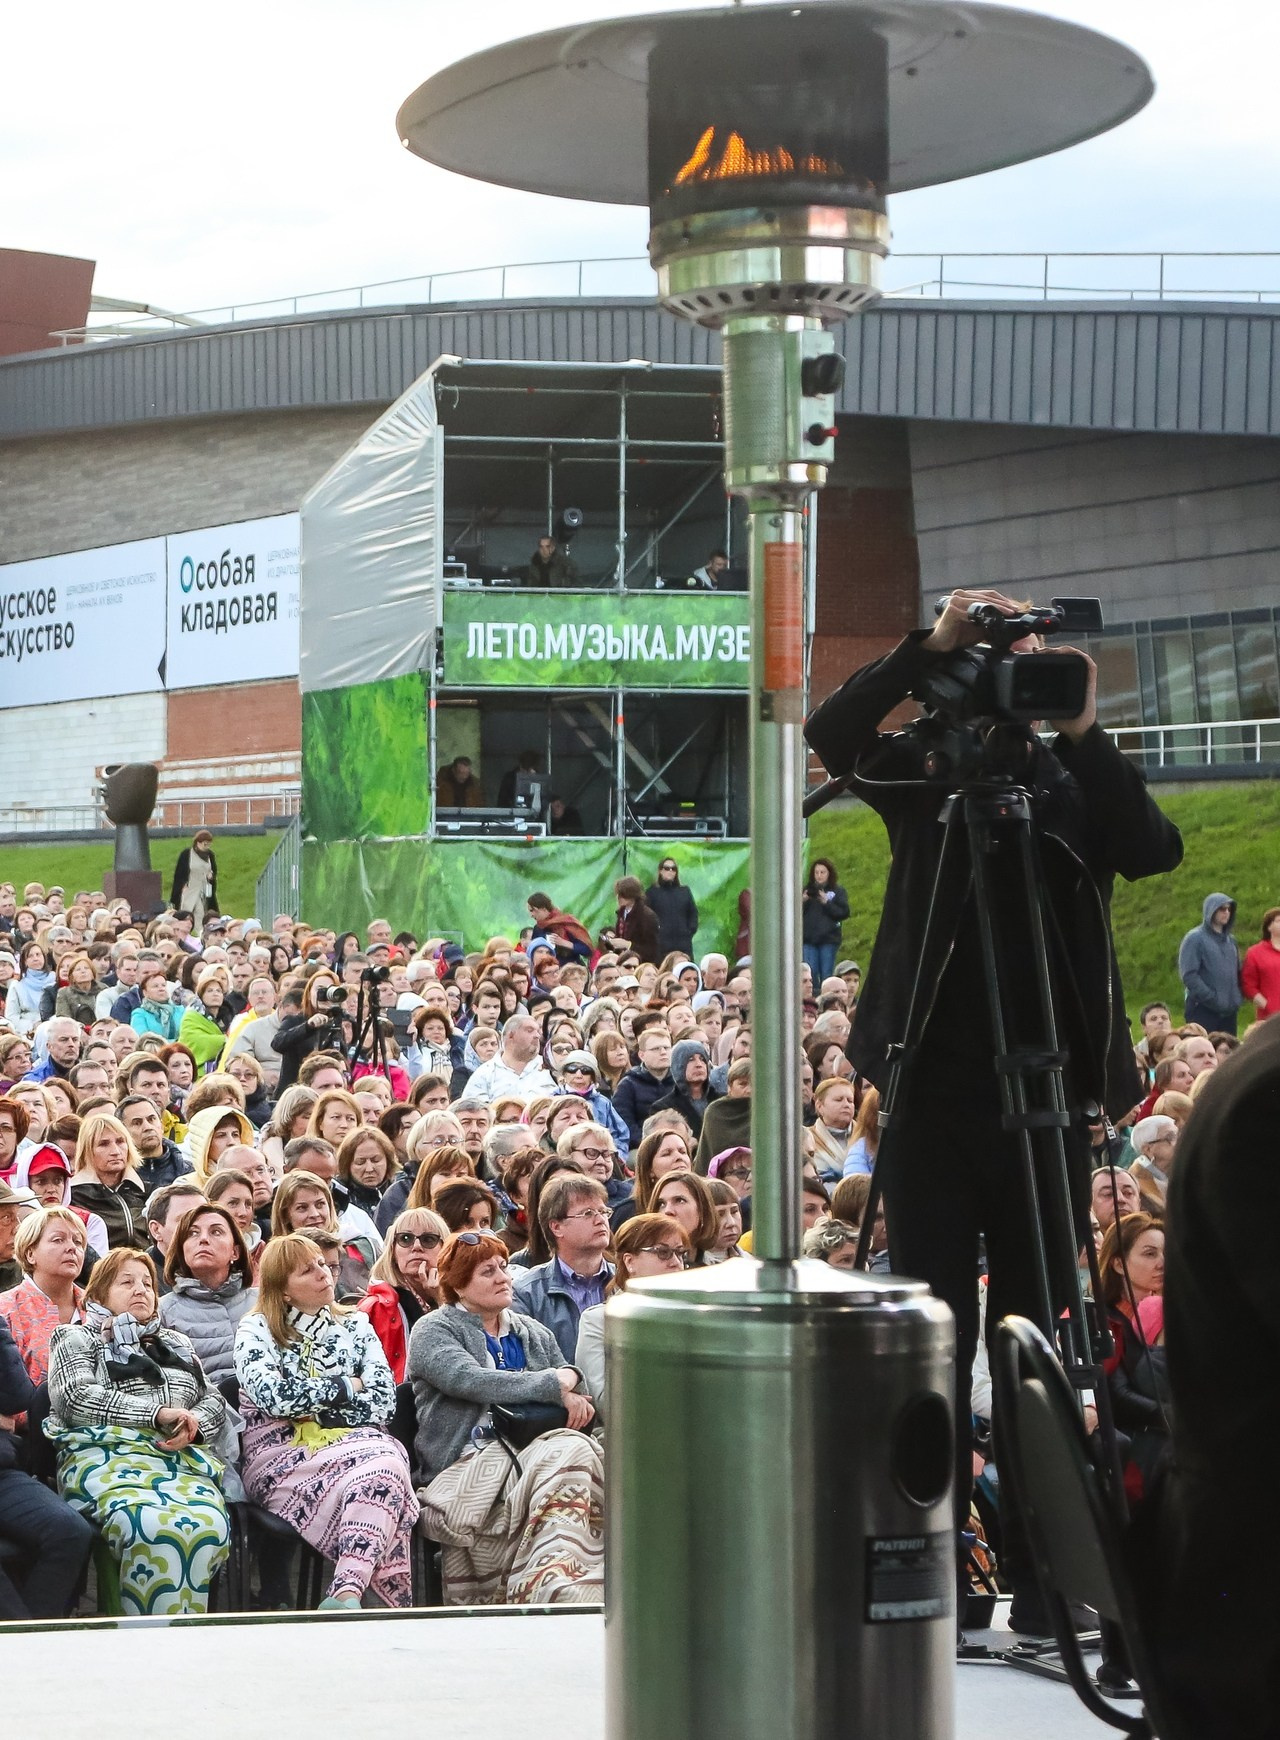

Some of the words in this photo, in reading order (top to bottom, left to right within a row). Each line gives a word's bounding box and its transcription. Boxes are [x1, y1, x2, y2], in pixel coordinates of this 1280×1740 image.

[180, 548, 256, 593] Особая
[181, 591, 277, 634] кладовая
[467, 621, 751, 662] ЛЕТО.МУЗЫКА.МУЗЕ
